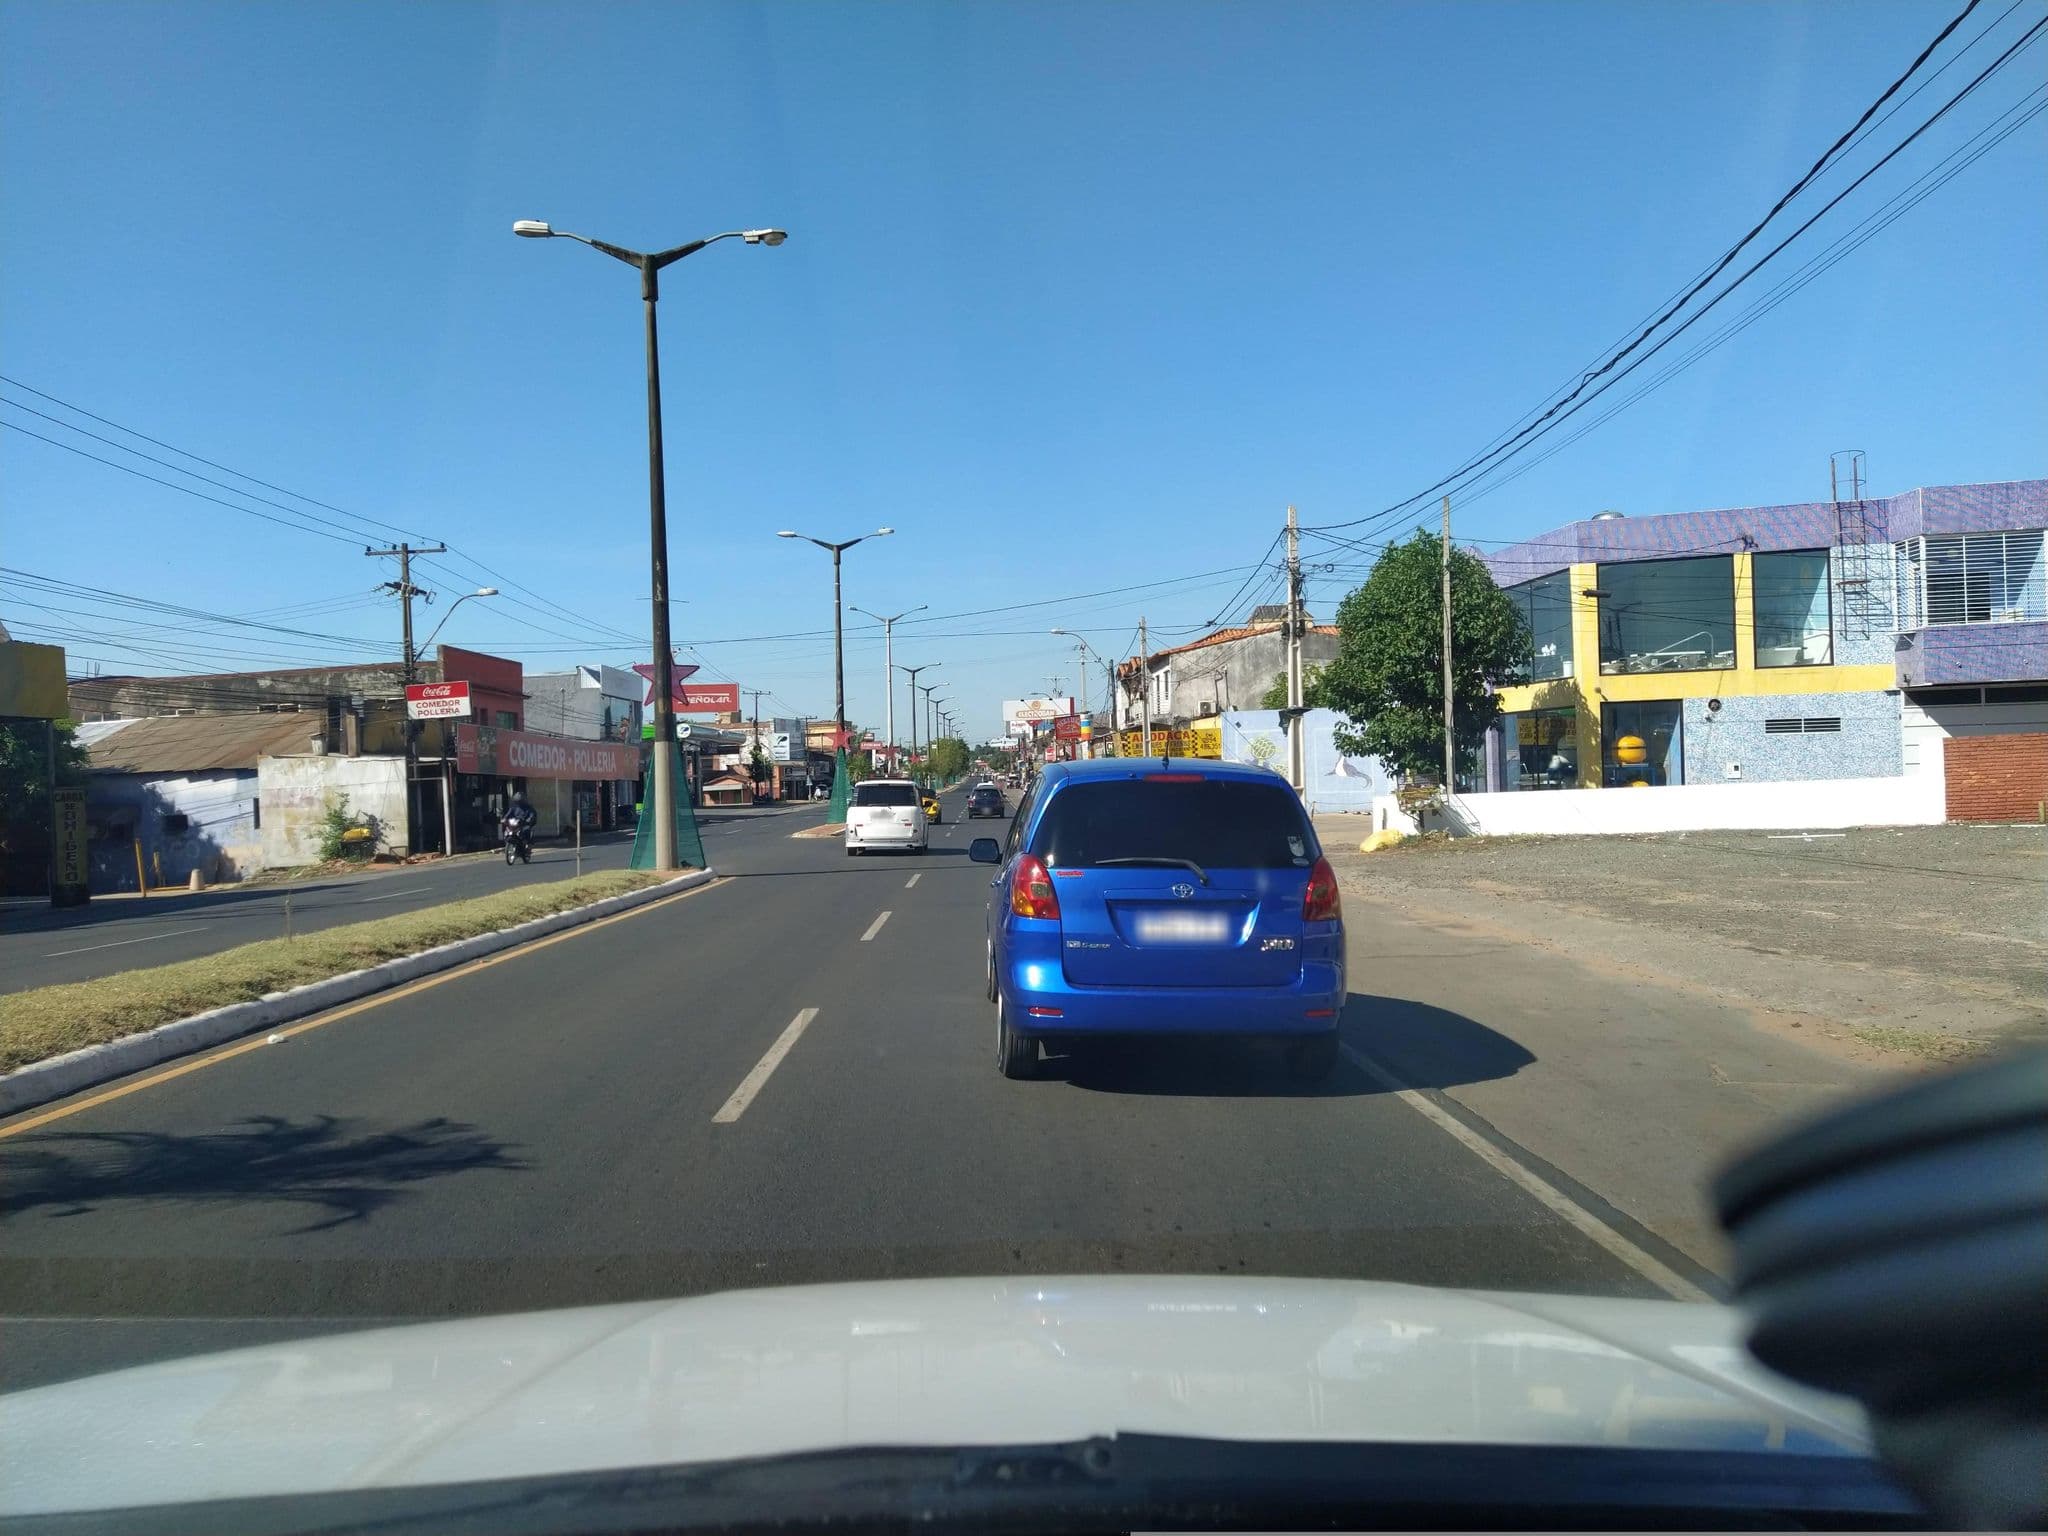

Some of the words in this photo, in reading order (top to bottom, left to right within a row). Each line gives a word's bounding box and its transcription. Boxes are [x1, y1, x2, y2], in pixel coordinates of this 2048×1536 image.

[415, 699, 461, 708] COMEDOR
[417, 707, 460, 717] POLLERIA
[509, 740, 567, 771] COMEDOR
[574, 748, 617, 773] POLLERIA
